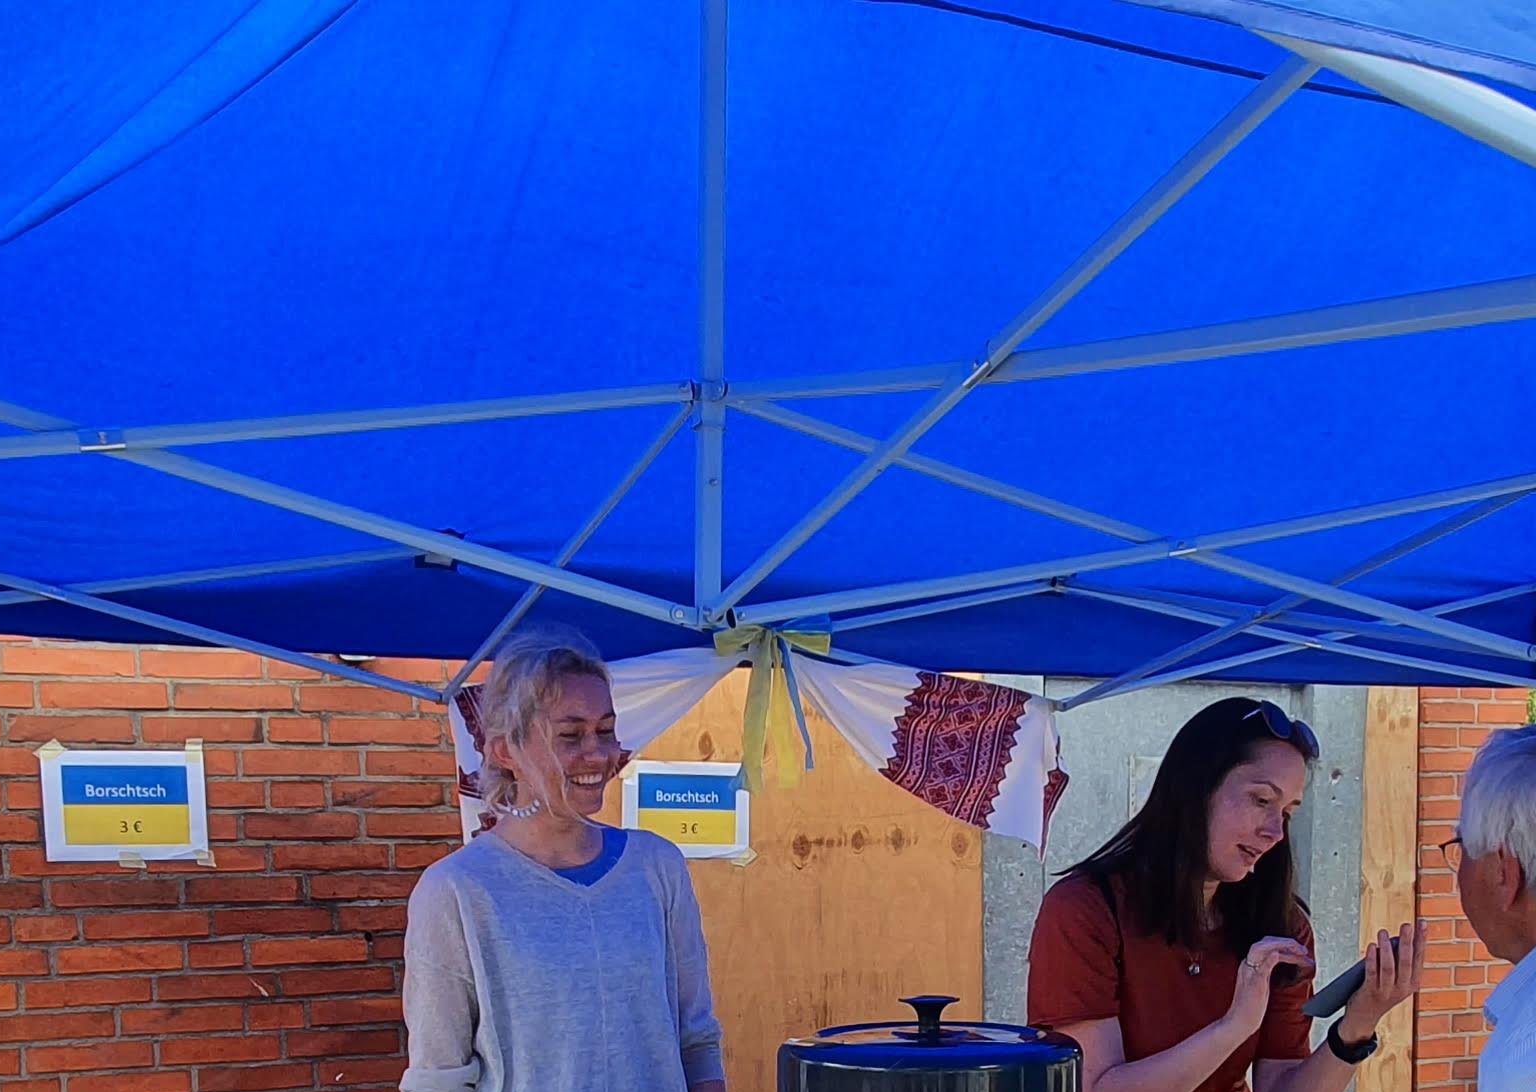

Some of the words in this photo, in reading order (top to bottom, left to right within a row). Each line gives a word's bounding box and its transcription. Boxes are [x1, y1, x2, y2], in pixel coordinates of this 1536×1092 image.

[84, 783, 167, 798] Borschtsch
[655, 789, 719, 804] Borschtsch
[120, 820, 129, 834] 3
[133, 820, 143, 834] €
[680, 823, 688, 834] 3
[691, 823, 699, 834] €
